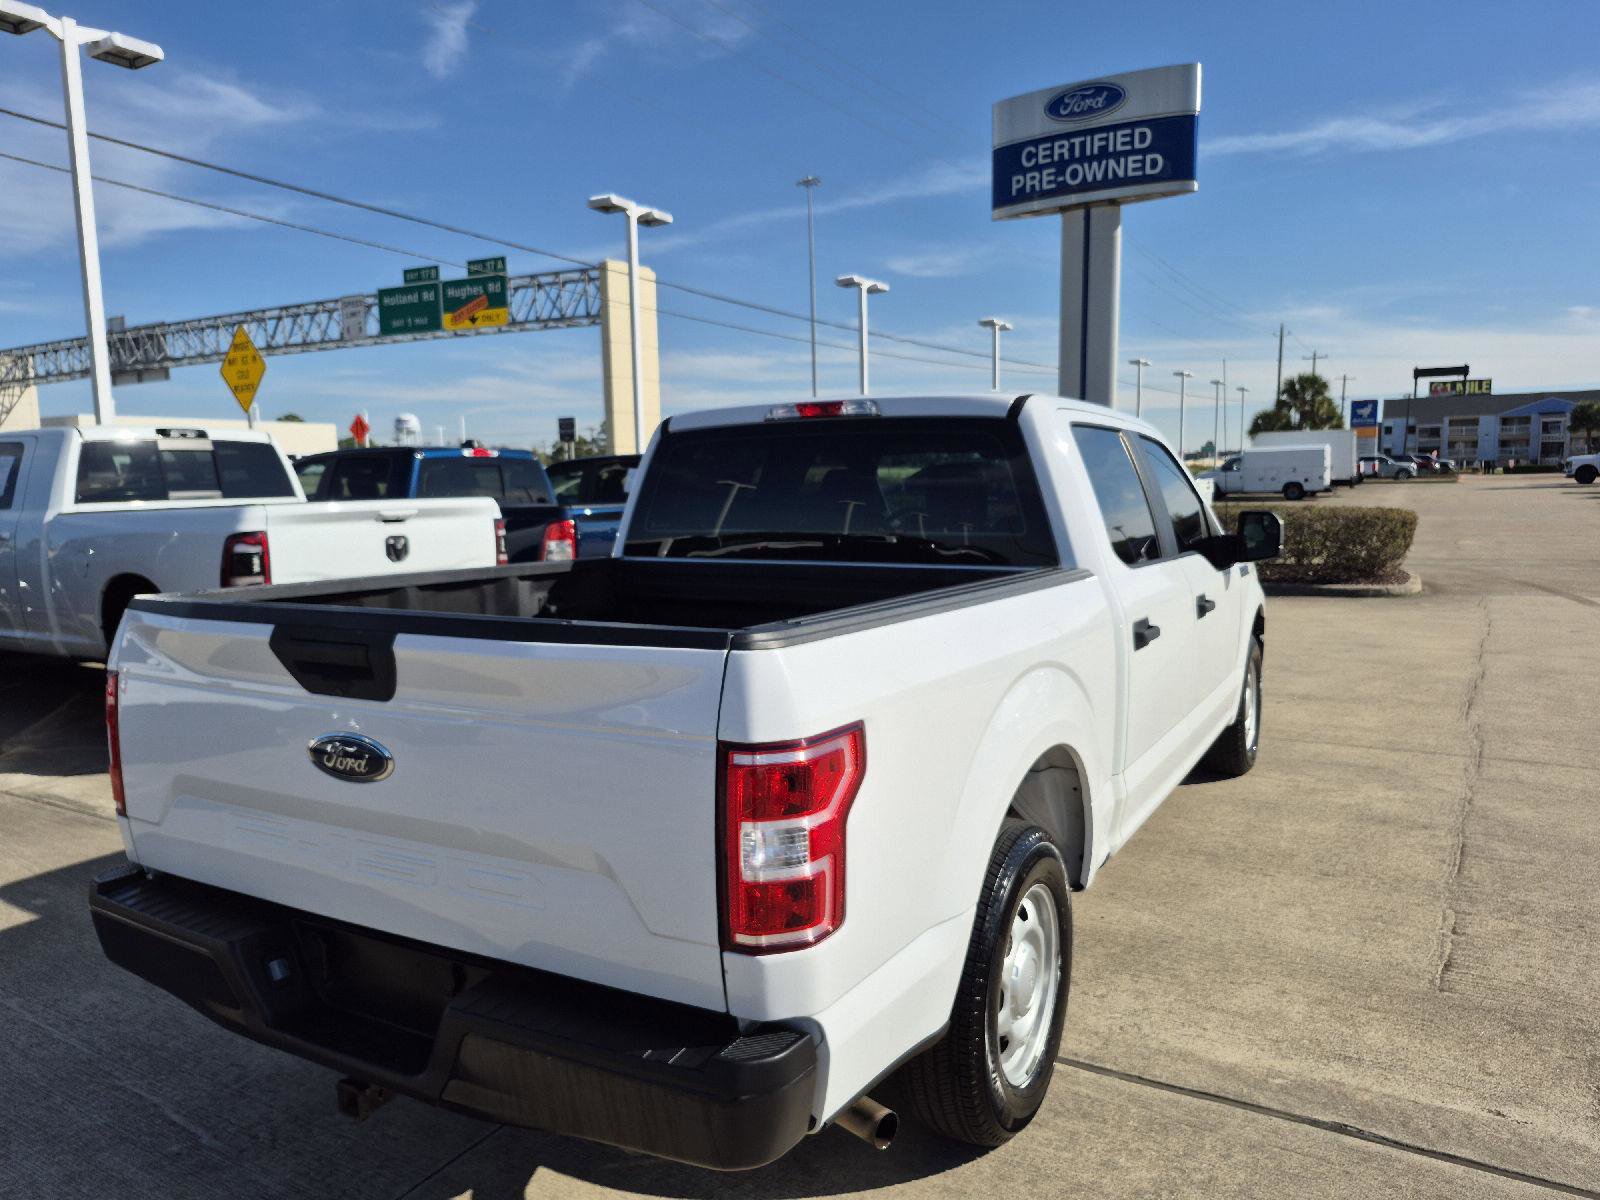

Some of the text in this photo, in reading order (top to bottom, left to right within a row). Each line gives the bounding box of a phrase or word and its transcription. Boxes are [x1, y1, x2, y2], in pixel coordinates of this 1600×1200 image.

[1059, 87, 1109, 116] Ford
[1021, 127, 1152, 168] CERTIFIED
[1011, 153, 1164, 197] PRE-OWNED
[383, 289, 435, 306] Holland Rd
[447, 280, 501, 299] Hughes Rd
[481, 312, 501, 322] ONLY
[323, 741, 369, 773] Ford
